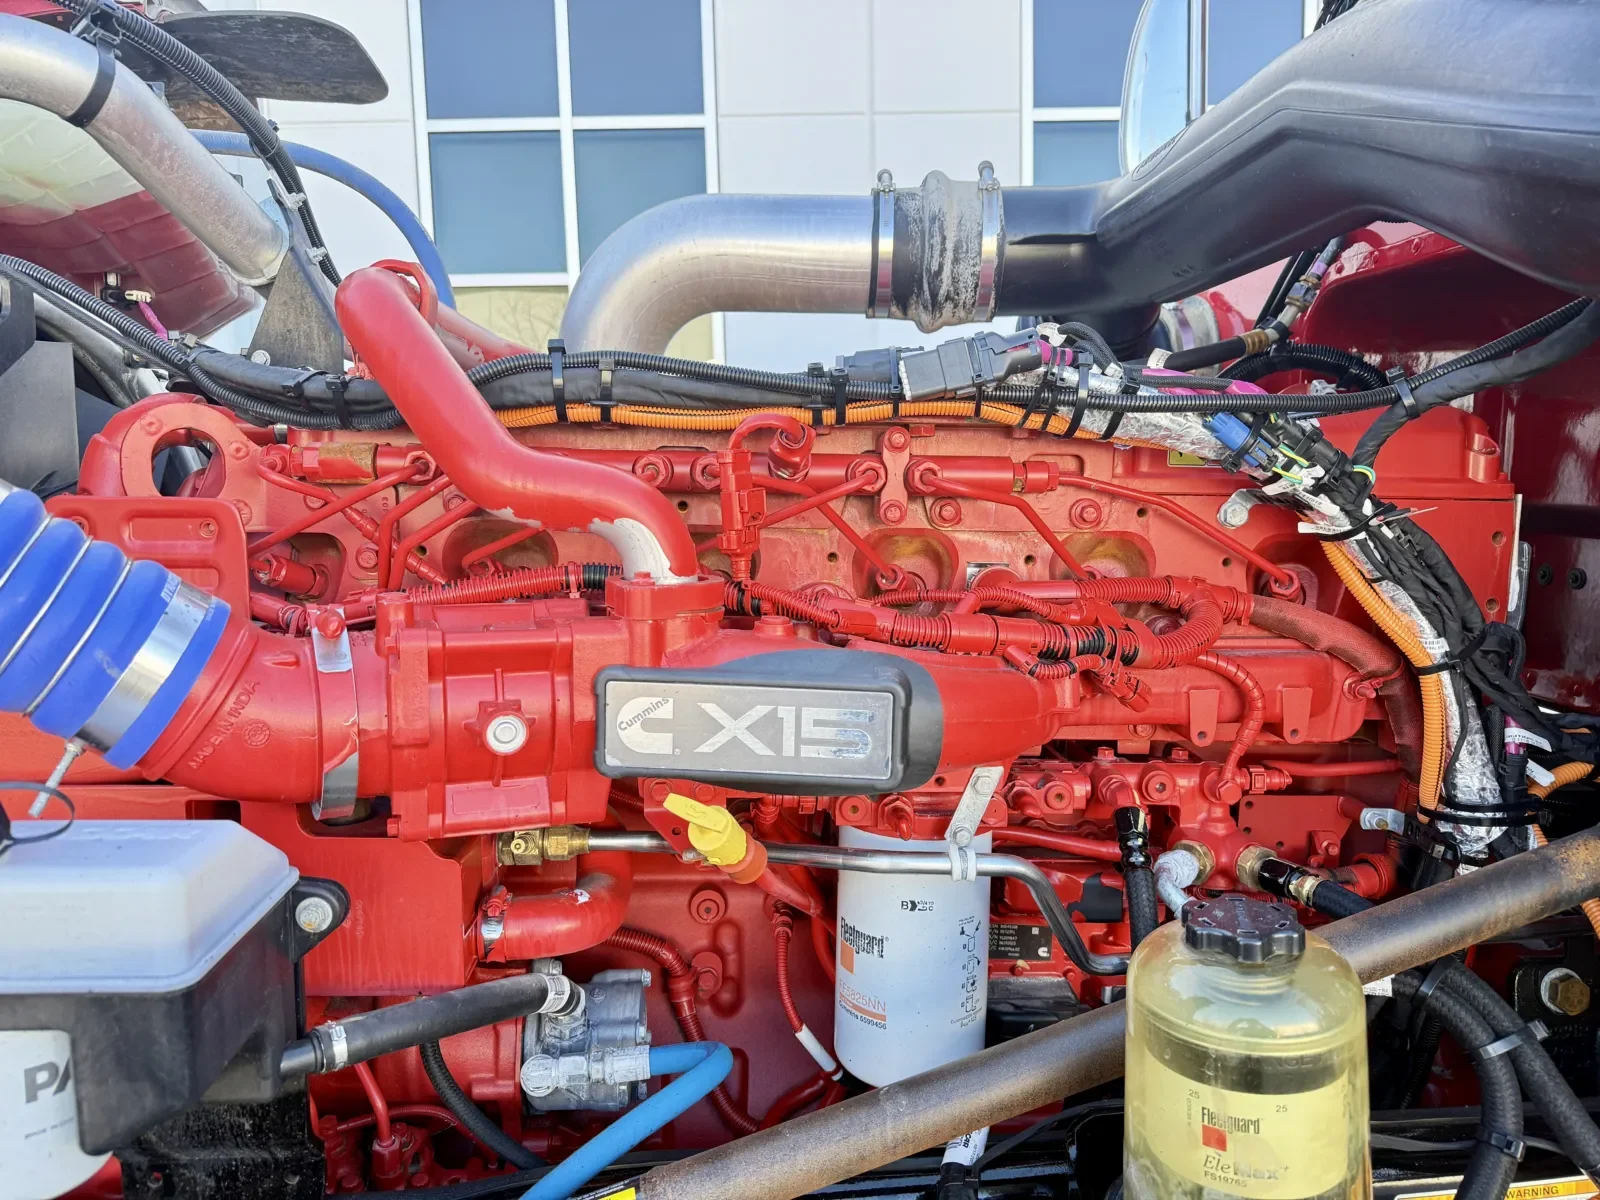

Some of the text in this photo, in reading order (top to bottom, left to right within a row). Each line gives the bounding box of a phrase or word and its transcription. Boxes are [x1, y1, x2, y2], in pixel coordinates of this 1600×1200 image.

[188, 680, 261, 770] MADE IN INDIA
[617, 697, 670, 732] Cummins
[693, 702, 872, 760] X15
[901, 900, 909, 910] B
[840, 915, 884, 959] Fleetguard
[839, 999, 859, 1020] Cummins
[1188, 1089, 1201, 1099] 25
[1275, 1104, 1288, 1113] 25
[1201, 1106, 1260, 1135] Fleetguard
[1203, 1170, 1248, 1188] FS19765
[1506, 1185, 1559, 1200] WARNING
